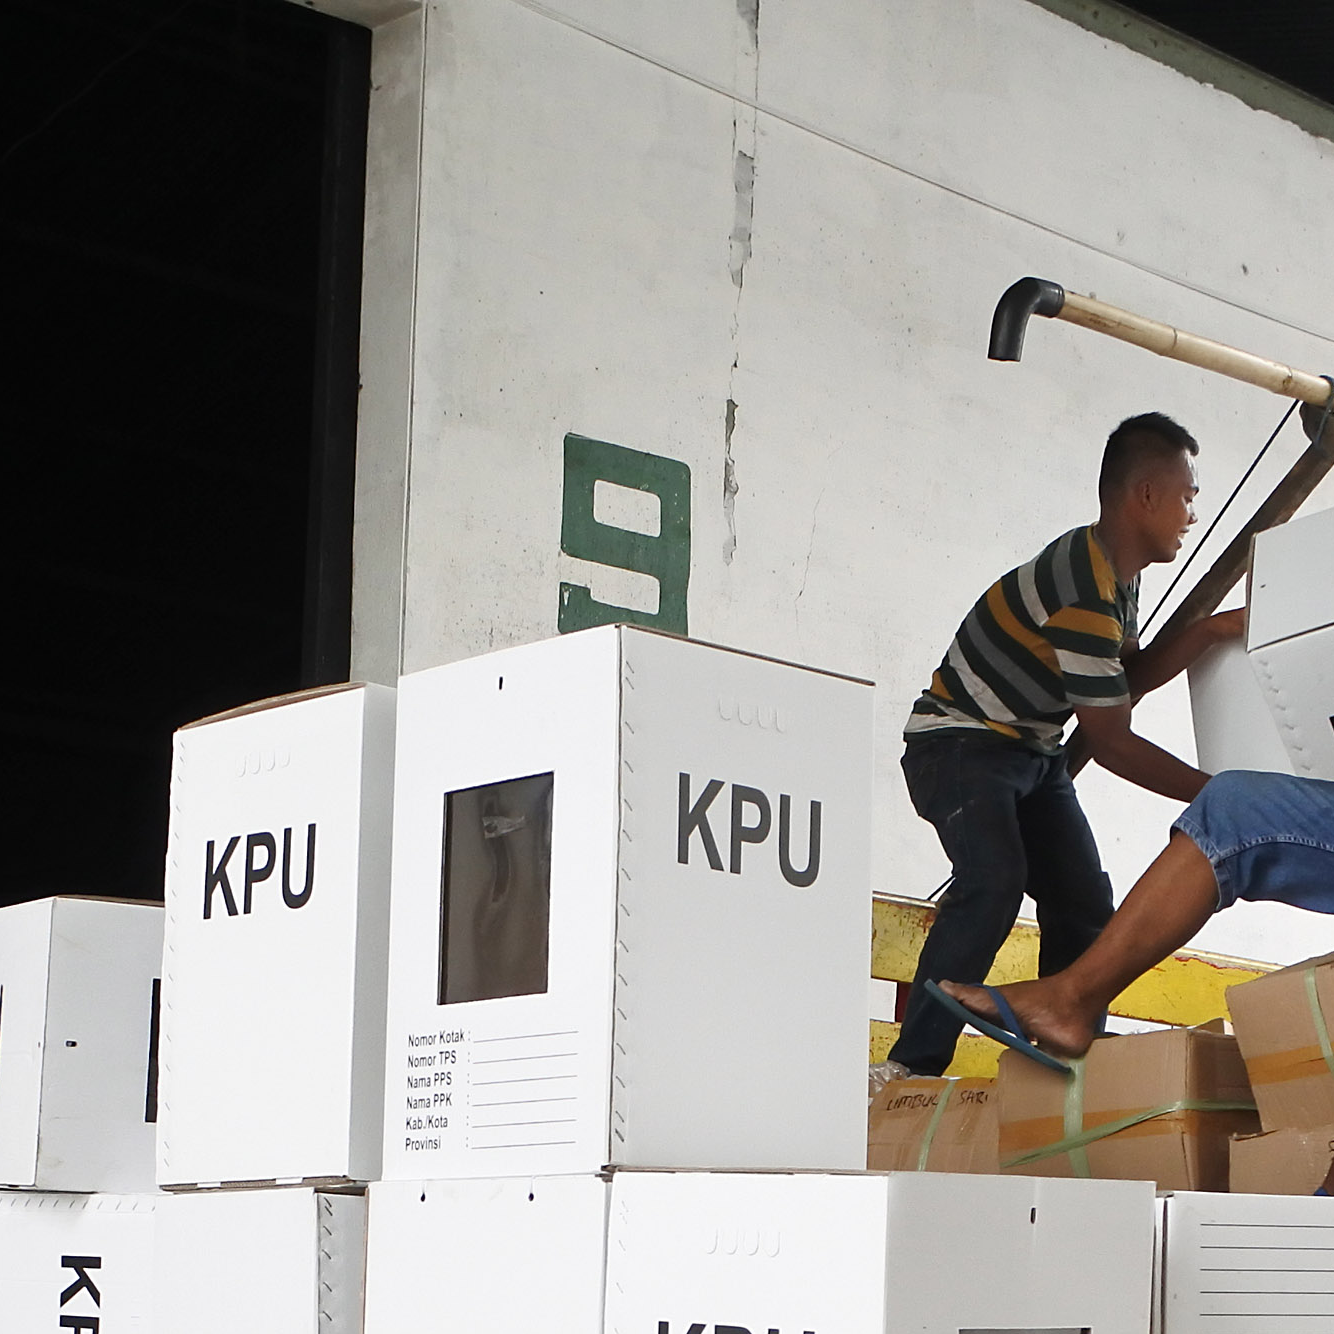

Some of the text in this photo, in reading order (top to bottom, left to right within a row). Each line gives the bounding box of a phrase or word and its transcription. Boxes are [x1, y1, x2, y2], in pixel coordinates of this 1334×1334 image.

[558, 432, 691, 637] 9
[677, 772, 822, 888] KPU
[203, 823, 317, 920] KPU
[408, 1028, 465, 1048] Nomor Kotak
[408, 1050, 457, 1069] Nomor TPS
[407, 1071, 452, 1089] Nama PPS
[407, 1092, 452, 1110] Nama PPK
[405, 1115, 448, 1131] Kab./Kota
[405, 1136, 441, 1151] Provinsi
